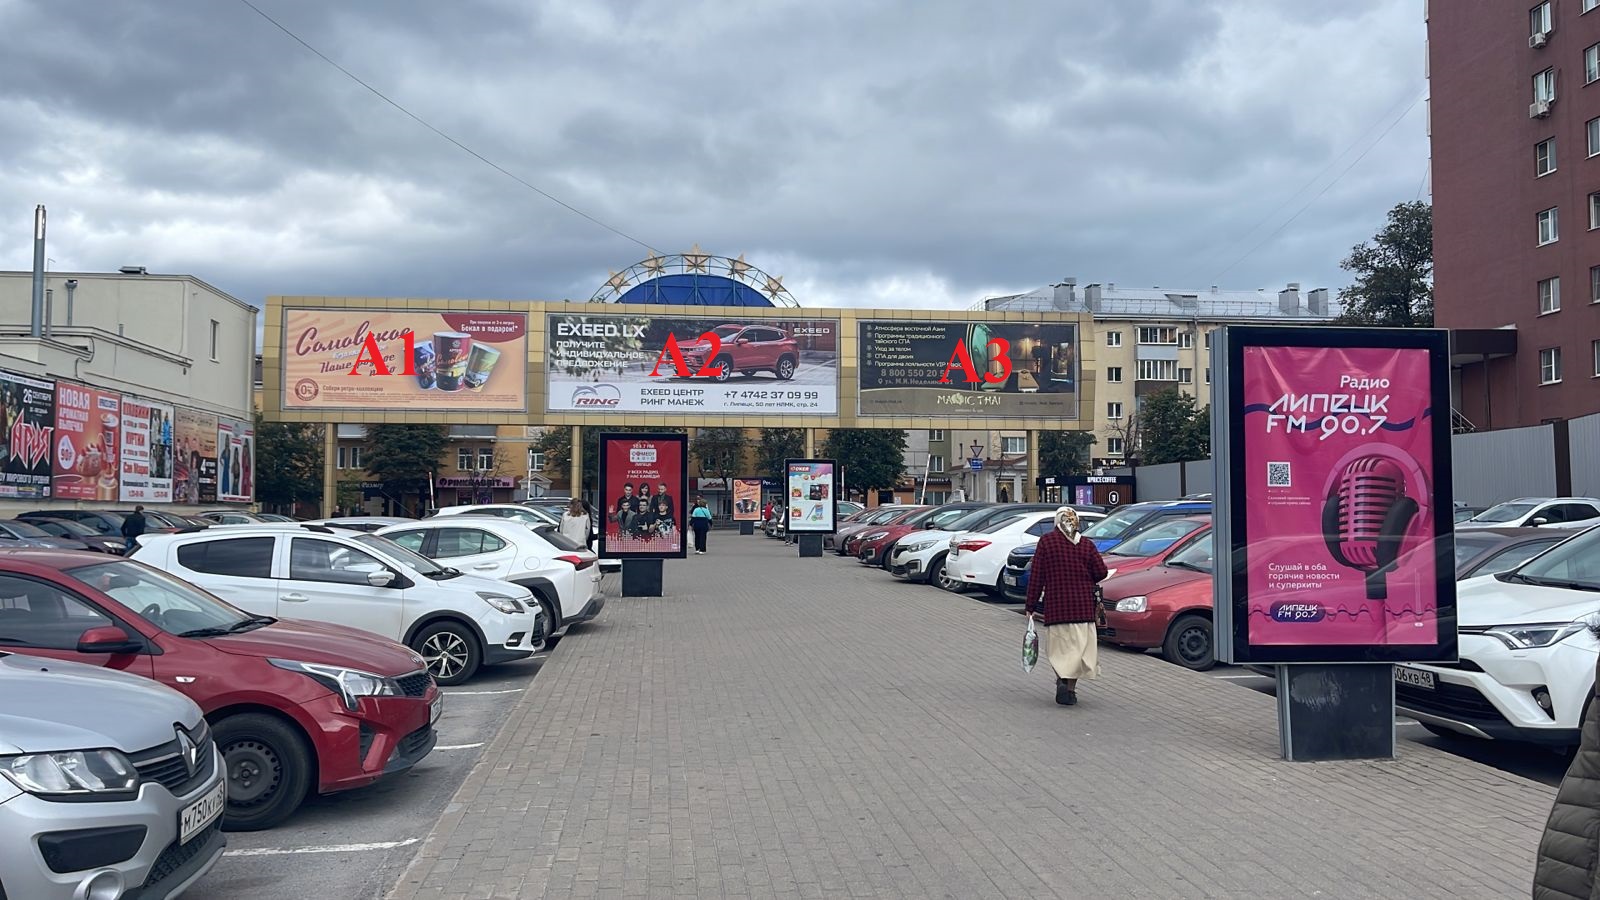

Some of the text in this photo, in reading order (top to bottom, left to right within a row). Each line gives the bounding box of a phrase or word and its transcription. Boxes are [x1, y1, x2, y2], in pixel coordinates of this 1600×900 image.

[461, 323, 480, 332] Бокал
[557, 322, 646, 338] EXEED LX
[874, 325, 904, 333] Атмосфера
[556, 340, 606, 349] ПОЛУЧИТЕ
[556, 350, 645, 359] ИНДИВИДУАЛЬНОЕ
[556, 360, 629, 368] ПРЕДЛОЖЕНИЕ
[881, 369, 887, 378] 8
[889, 369, 906, 378] 800
[907, 369, 924, 378] 550
[926, 369, 938, 378] 20
[1340, 375, 1390, 390] Радио
[23, 388, 33, 404] 26
[640, 388, 705, 397] EXEED ЦЕНТР
[723, 391, 819, 400] +7 4742 37 09 99
[59, 387, 90, 411] НОВАЯ
[640, 398, 705, 406] РИНГ МАНЕЖ
[1268, 393, 1390, 413] ЛИПЕЦК
[1266, 414, 1307, 434] FM
[1268, 562, 1303, 573] Слушай
[1311, 562, 1327, 571] оба
[1268, 573, 1340, 582] горячие новости
[1268, 582, 1322, 591] и суперхиты
[1279, 604, 1318, 612] ЛИПЕЦК
[1277, 610, 1292, 619] FM
